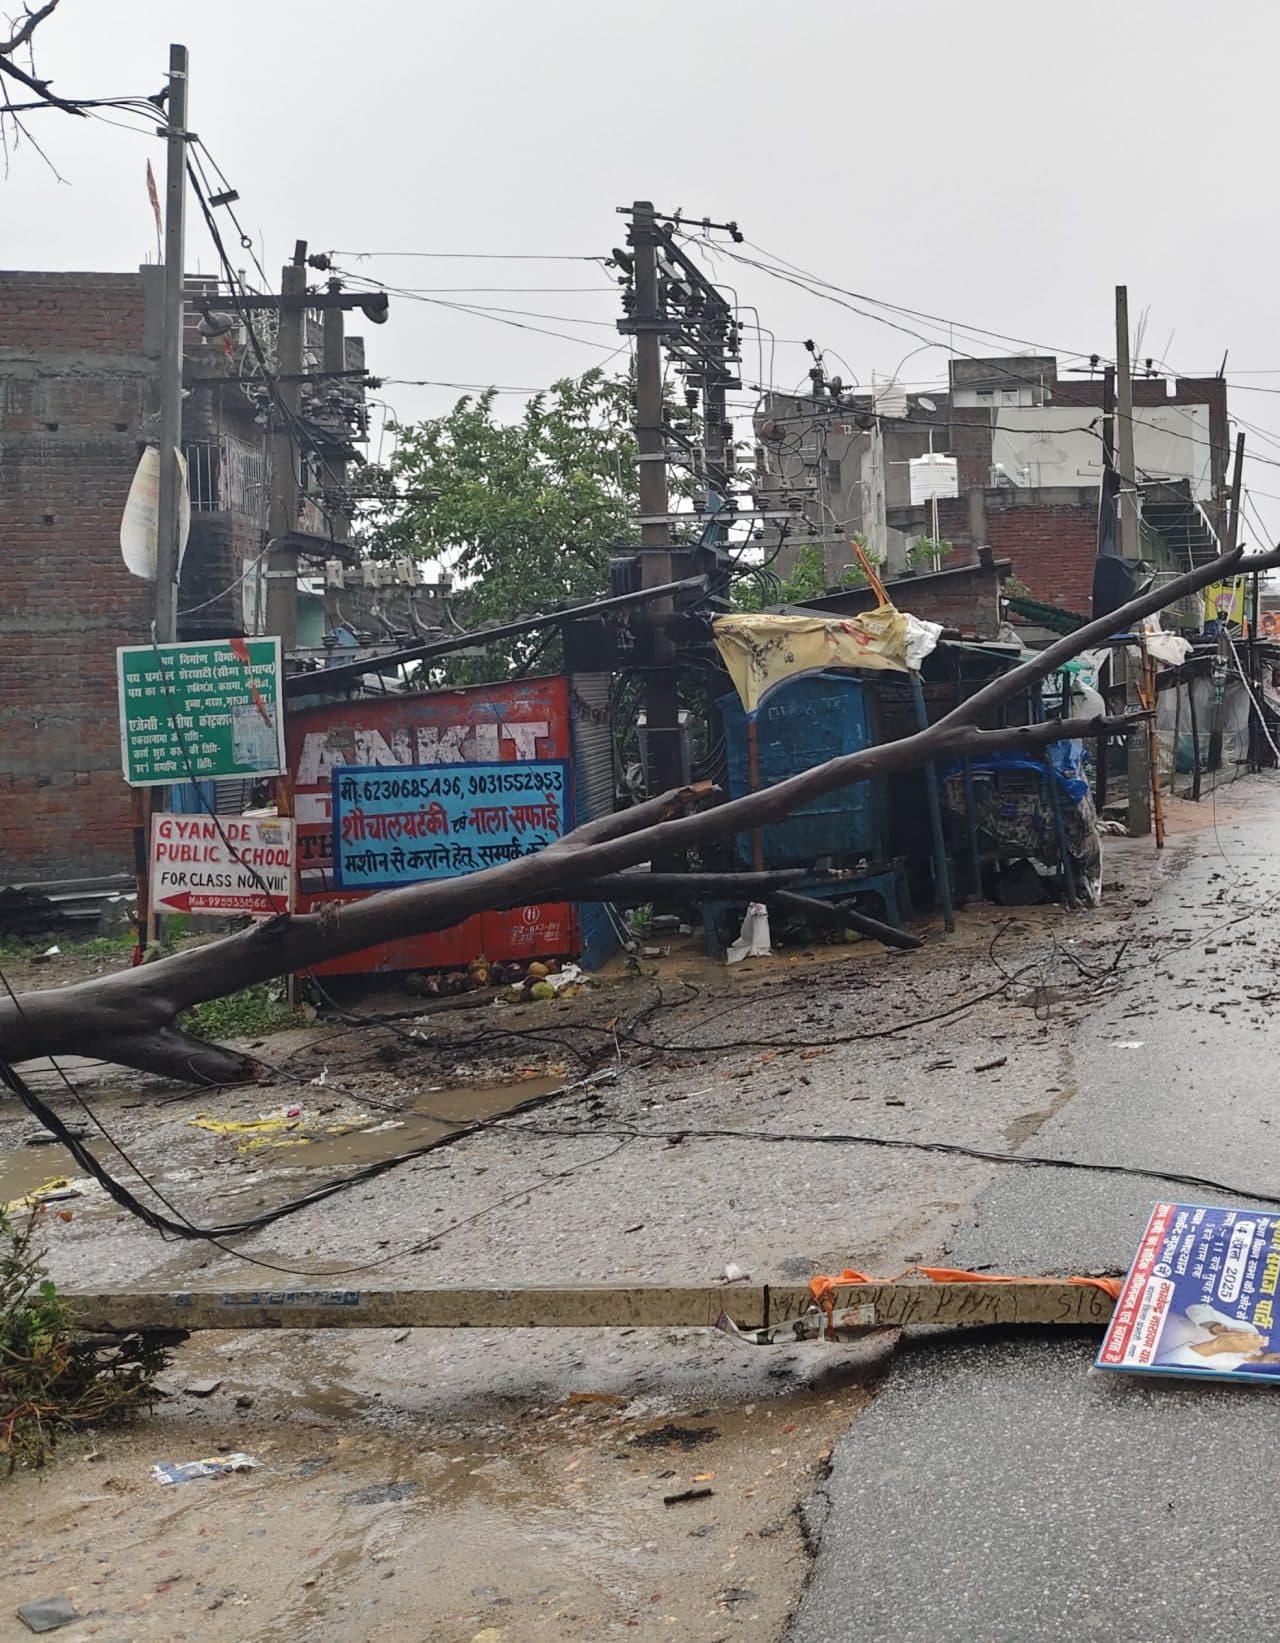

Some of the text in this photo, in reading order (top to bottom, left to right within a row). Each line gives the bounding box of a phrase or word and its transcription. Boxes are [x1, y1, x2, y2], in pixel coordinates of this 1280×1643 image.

[180, 653, 208, 665] निर्माण
[145, 670, 174, 682] प्रमंल
[145, 687, 156, 696] का
[295, 721, 550, 785] ANKIT
[468, 771, 563, 794] 9031552953
[468, 806, 508, 834] नाला
[510, 792, 561, 837] सफाई
[159, 820, 251, 842] GYAN DE
[156, 843, 291, 867] PUBLIC SCHOOL
[345, 847, 388, 876] मशीन
[390, 845, 406, 871] से
[408, 842, 450, 870] कराने
[477, 837, 525, 867] सम्पर्क
[161, 872, 187, 886] FOR
[190, 872, 232, 887] CLASS
[1196, 1242, 1209, 1261] शाम
[1213, 1241, 1224, 1252] 11
[1246, 1259, 1257, 1279] सभा
[1260, 1251, 1280, 1295] समाज
[1220, 1266, 1237, 1298] 2025
[1056, 1292, 1104, 1319] 516
[1153, 1282, 1173, 1313] राघवेन्द्र
[1253, 1299, 1276, 1329] पार्टी
[1143, 1314, 1161, 1347] नारायण
